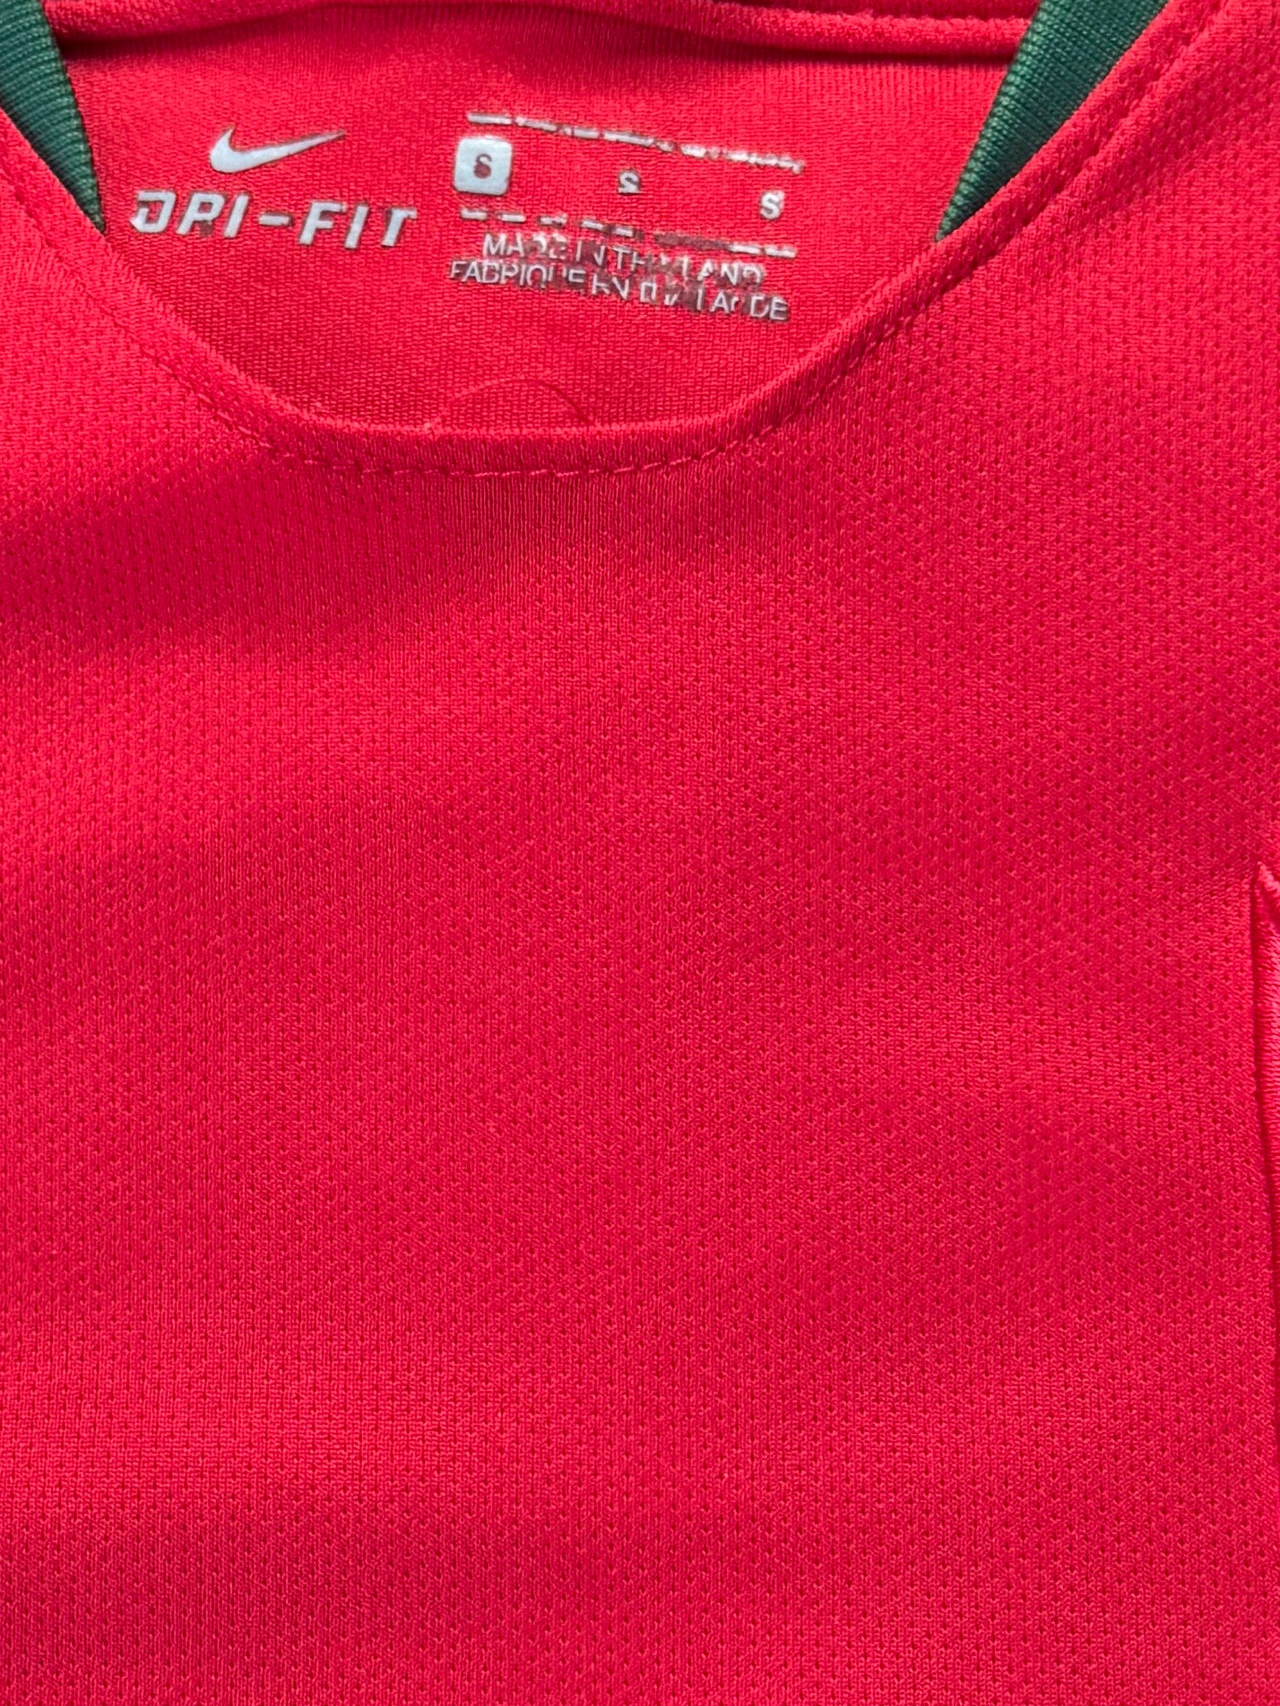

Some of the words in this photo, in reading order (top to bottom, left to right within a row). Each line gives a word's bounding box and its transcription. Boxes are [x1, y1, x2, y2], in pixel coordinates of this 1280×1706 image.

[130, 189, 418, 250] DRI-FIT
[619, 169, 641, 194] S
[760, 191, 784, 221] S
